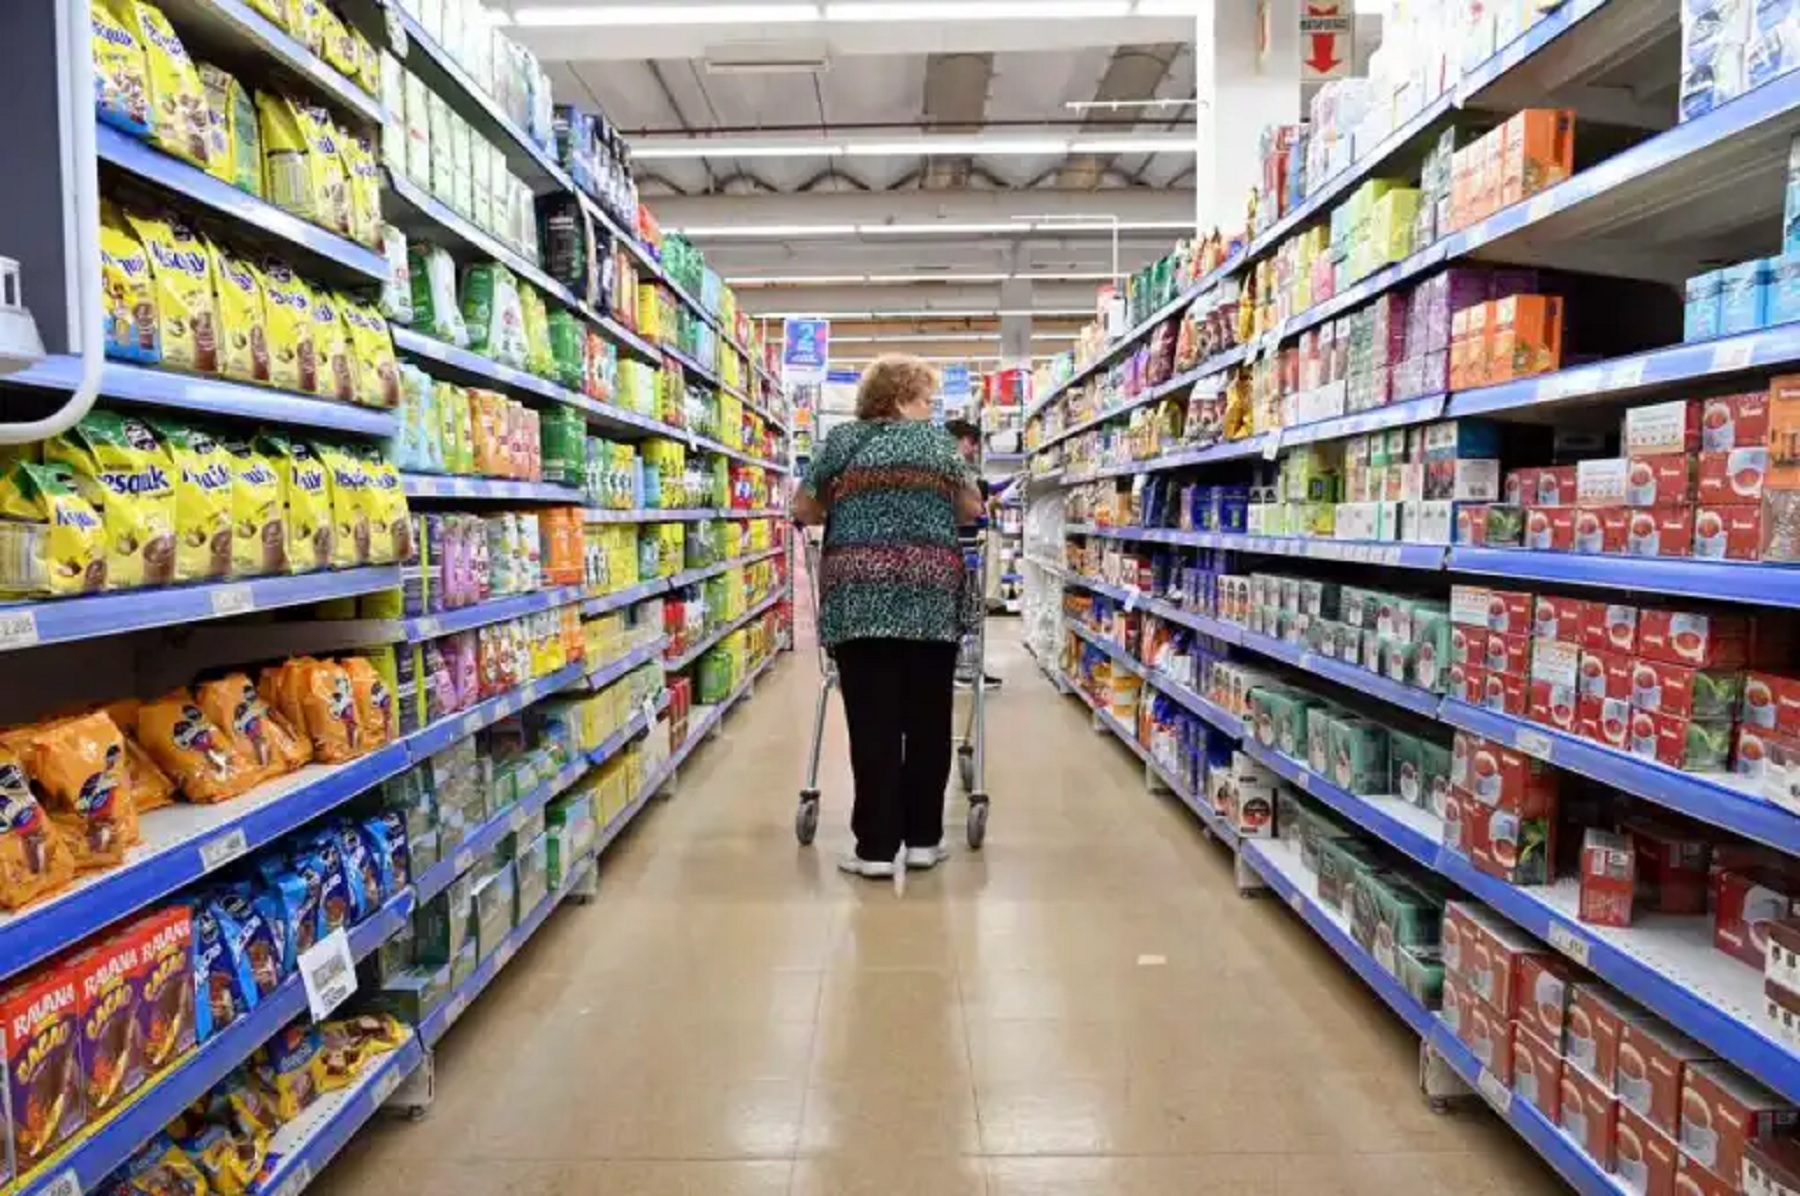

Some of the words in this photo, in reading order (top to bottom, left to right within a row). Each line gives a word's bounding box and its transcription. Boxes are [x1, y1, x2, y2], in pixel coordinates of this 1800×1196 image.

[142, 919, 191, 964] RAVANA
[83, 948, 138, 1001] RAVANA
[13, 982, 75, 1041] RAVANA
